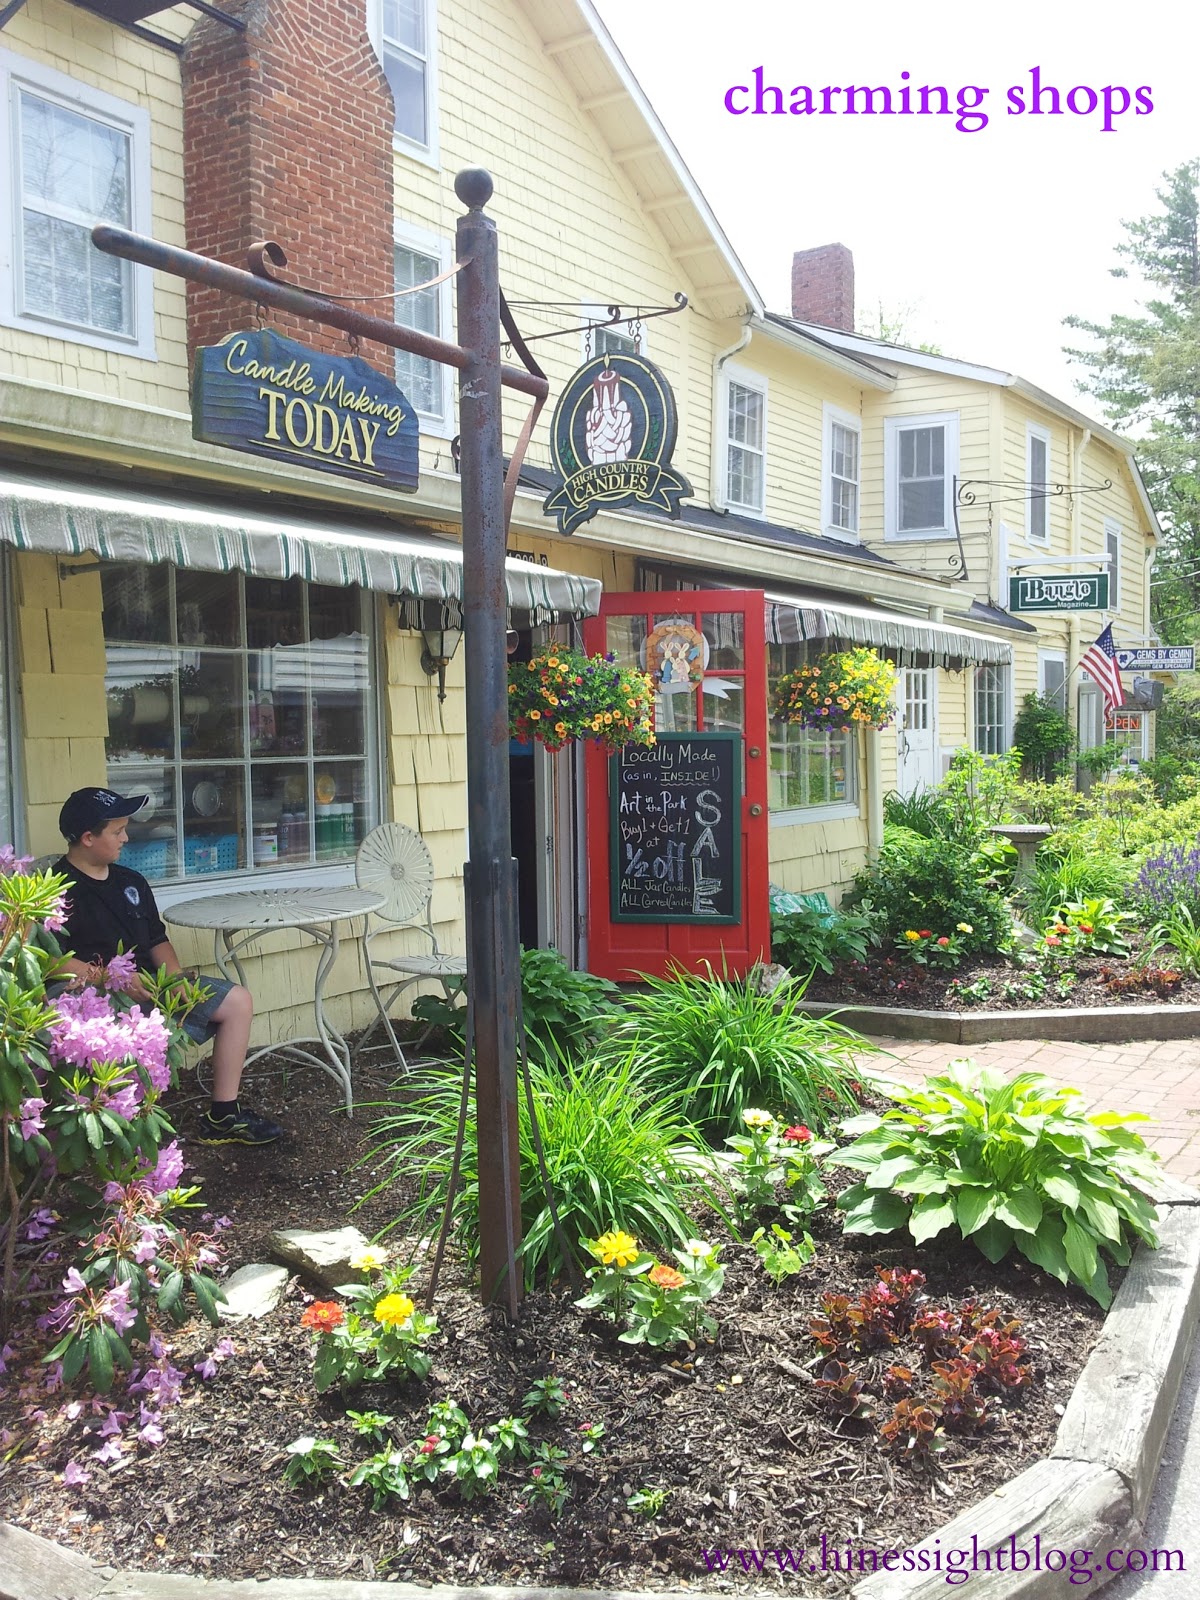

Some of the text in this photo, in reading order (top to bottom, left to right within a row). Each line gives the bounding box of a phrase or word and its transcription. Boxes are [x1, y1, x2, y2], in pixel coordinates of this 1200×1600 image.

[226, 339, 406, 437] Candle Making
[260, 387, 381, 467] TODAY
[572, 463, 650, 488] HIGH COUNTRY
[574, 473, 649, 502] CANDLES
[1025, 578, 1091, 601] Bangle
[1057, 601, 1090, 609] Magazine
[1136, 648, 1192, 660] GEMS BY GEMINI
[1105, 717, 1139, 730] OPEN
[622, 743, 716, 769] Locally Made
[622, 769, 640, 783] (as
[620, 790, 688, 816] Art in the Park
[620, 820, 643, 843] Buy
[658, 816, 682, 833] Get
[646, 836, 660, 848] at
[621, 878, 691, 894] ALL Jar Candles
[621, 892, 641, 908] ALL
[641, 893, 669, 909] Carved
